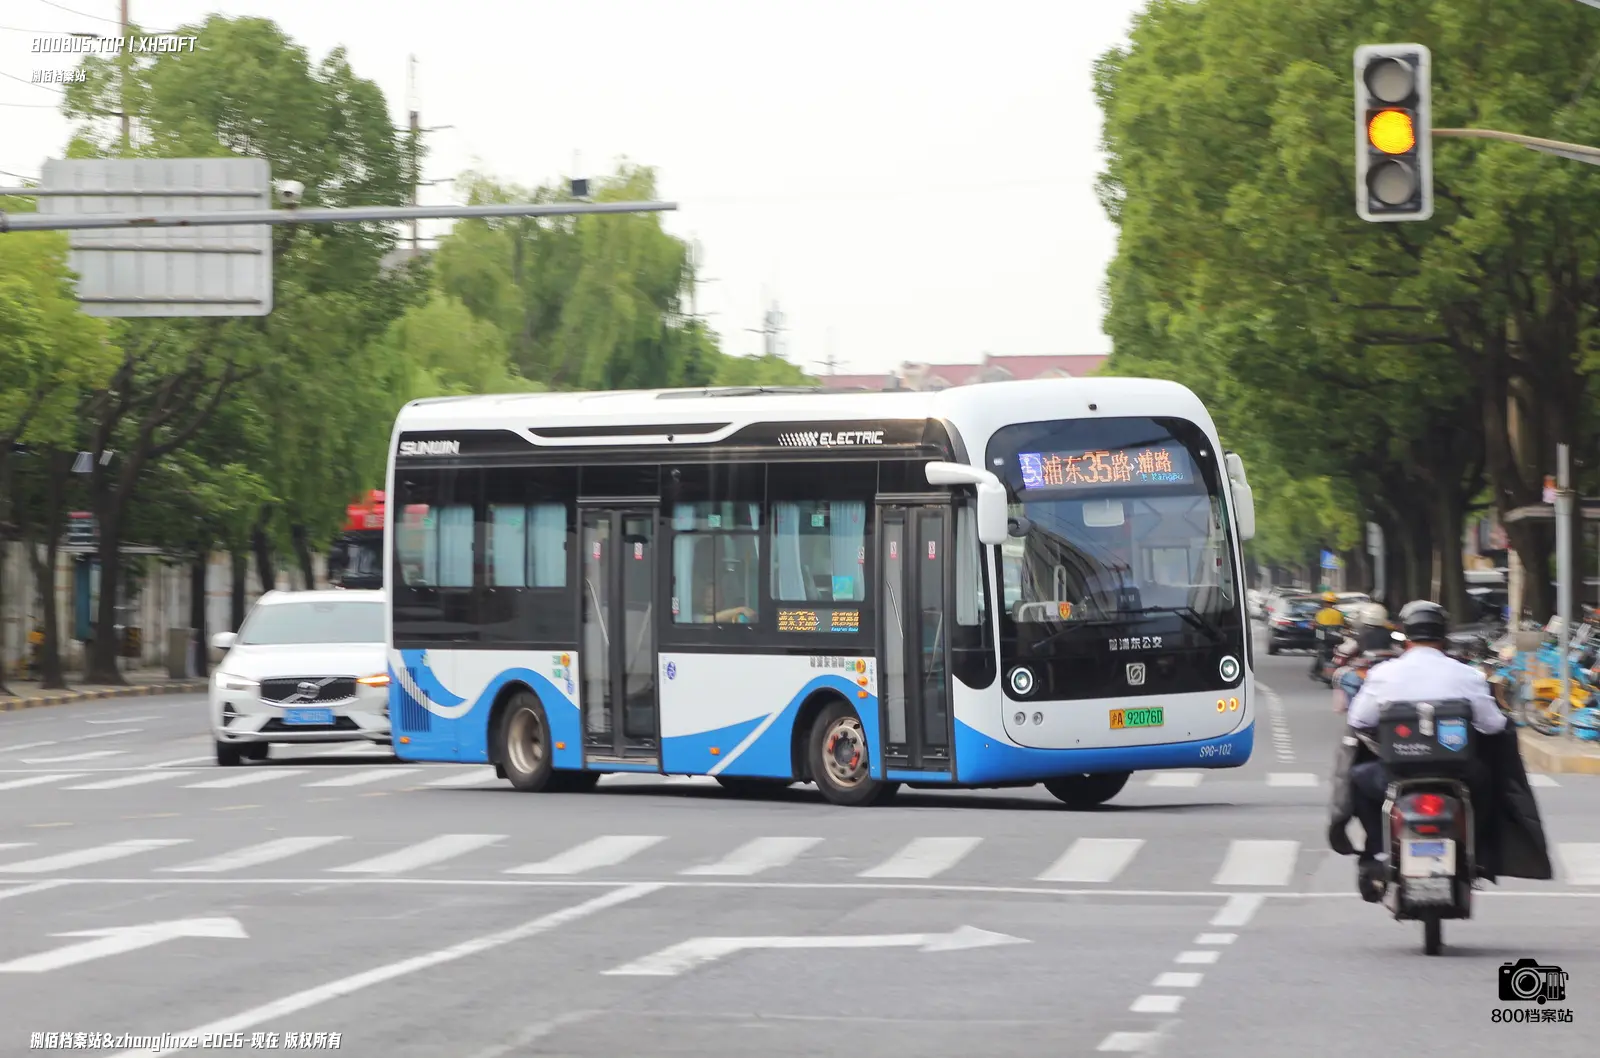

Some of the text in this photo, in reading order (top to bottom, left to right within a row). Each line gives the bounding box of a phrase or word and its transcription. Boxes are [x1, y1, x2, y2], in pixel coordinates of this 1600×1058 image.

[819, 430, 884, 446] ELECTRIC
[399, 440, 460, 456] SUNWIN
[1042, 451, 1131, 485] 浦东35路
[1119, 636, 1162, 650] 浦东公交
[1127, 709, 1162, 725] 92076D
[1199, 743, 1232, 758] S9G-102
